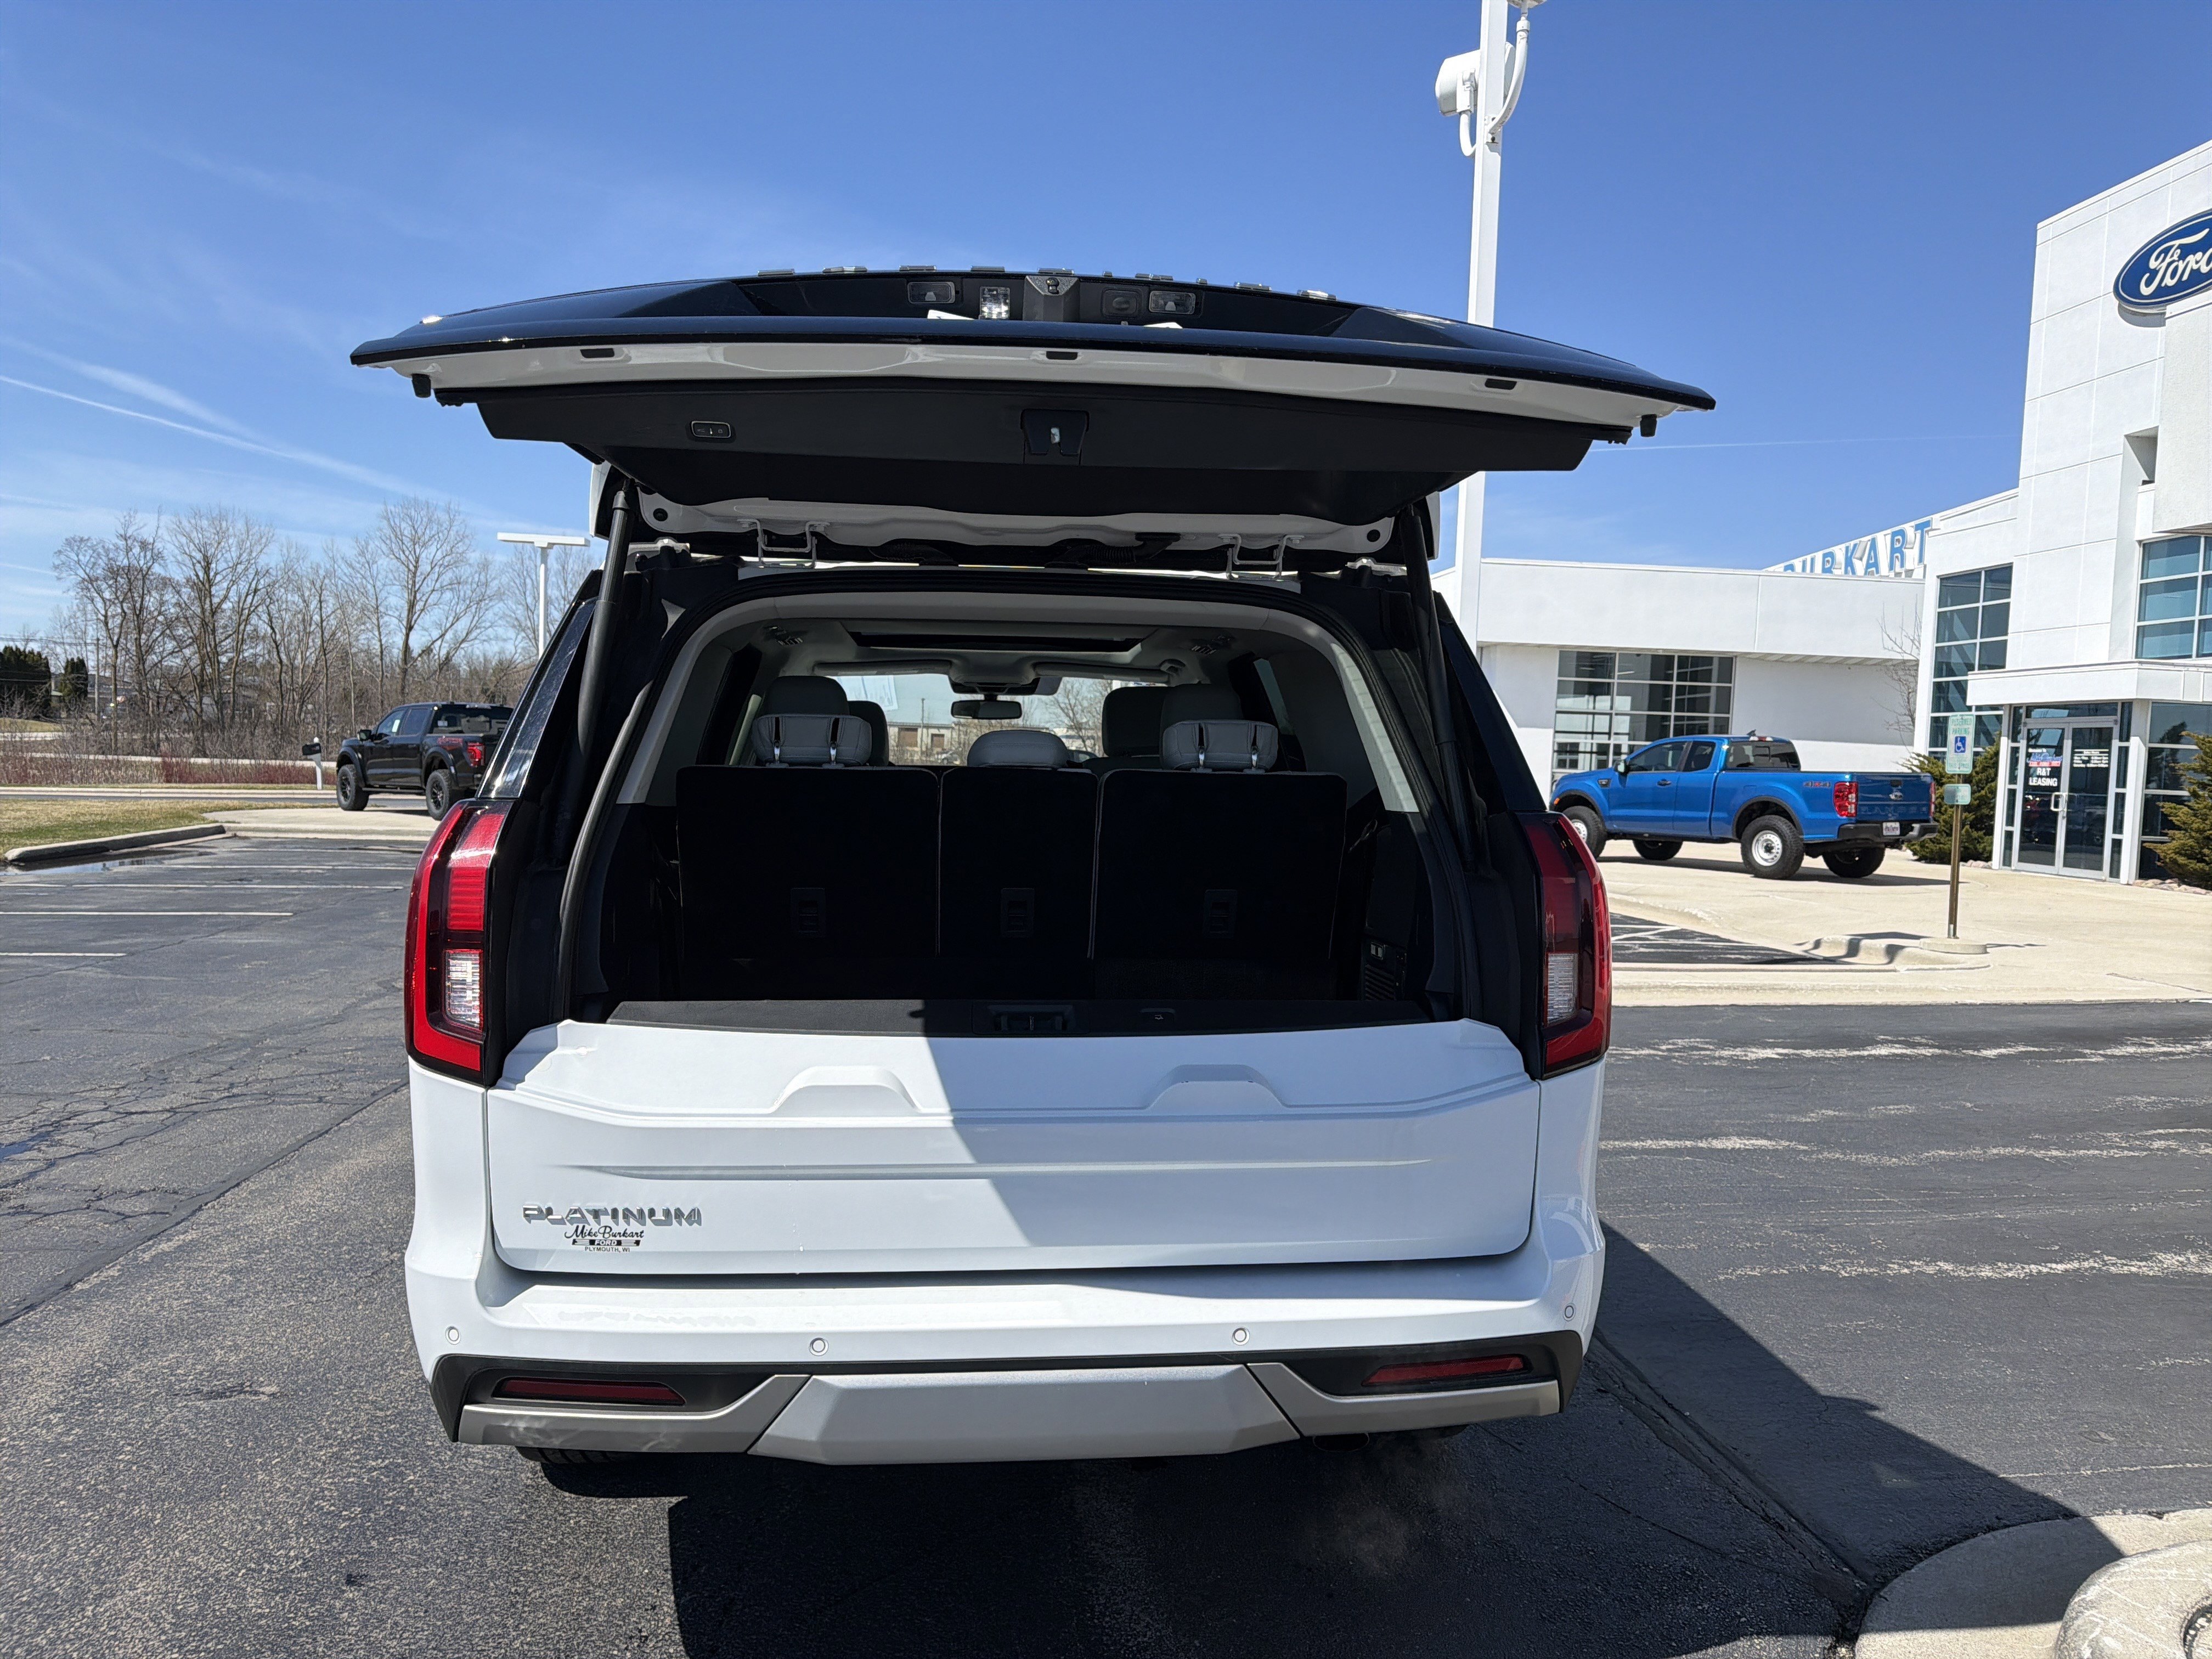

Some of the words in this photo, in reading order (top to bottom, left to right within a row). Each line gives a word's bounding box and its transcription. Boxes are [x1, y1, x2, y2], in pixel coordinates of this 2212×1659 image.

[2037, 768, 2051, 776] R&T
[2029, 777, 2058, 787] LEASING
[522, 1204, 701, 1224] PLATINUM
[565, 1224, 599, 1238] Mike
[597, 1225, 645, 1239] Burkart
